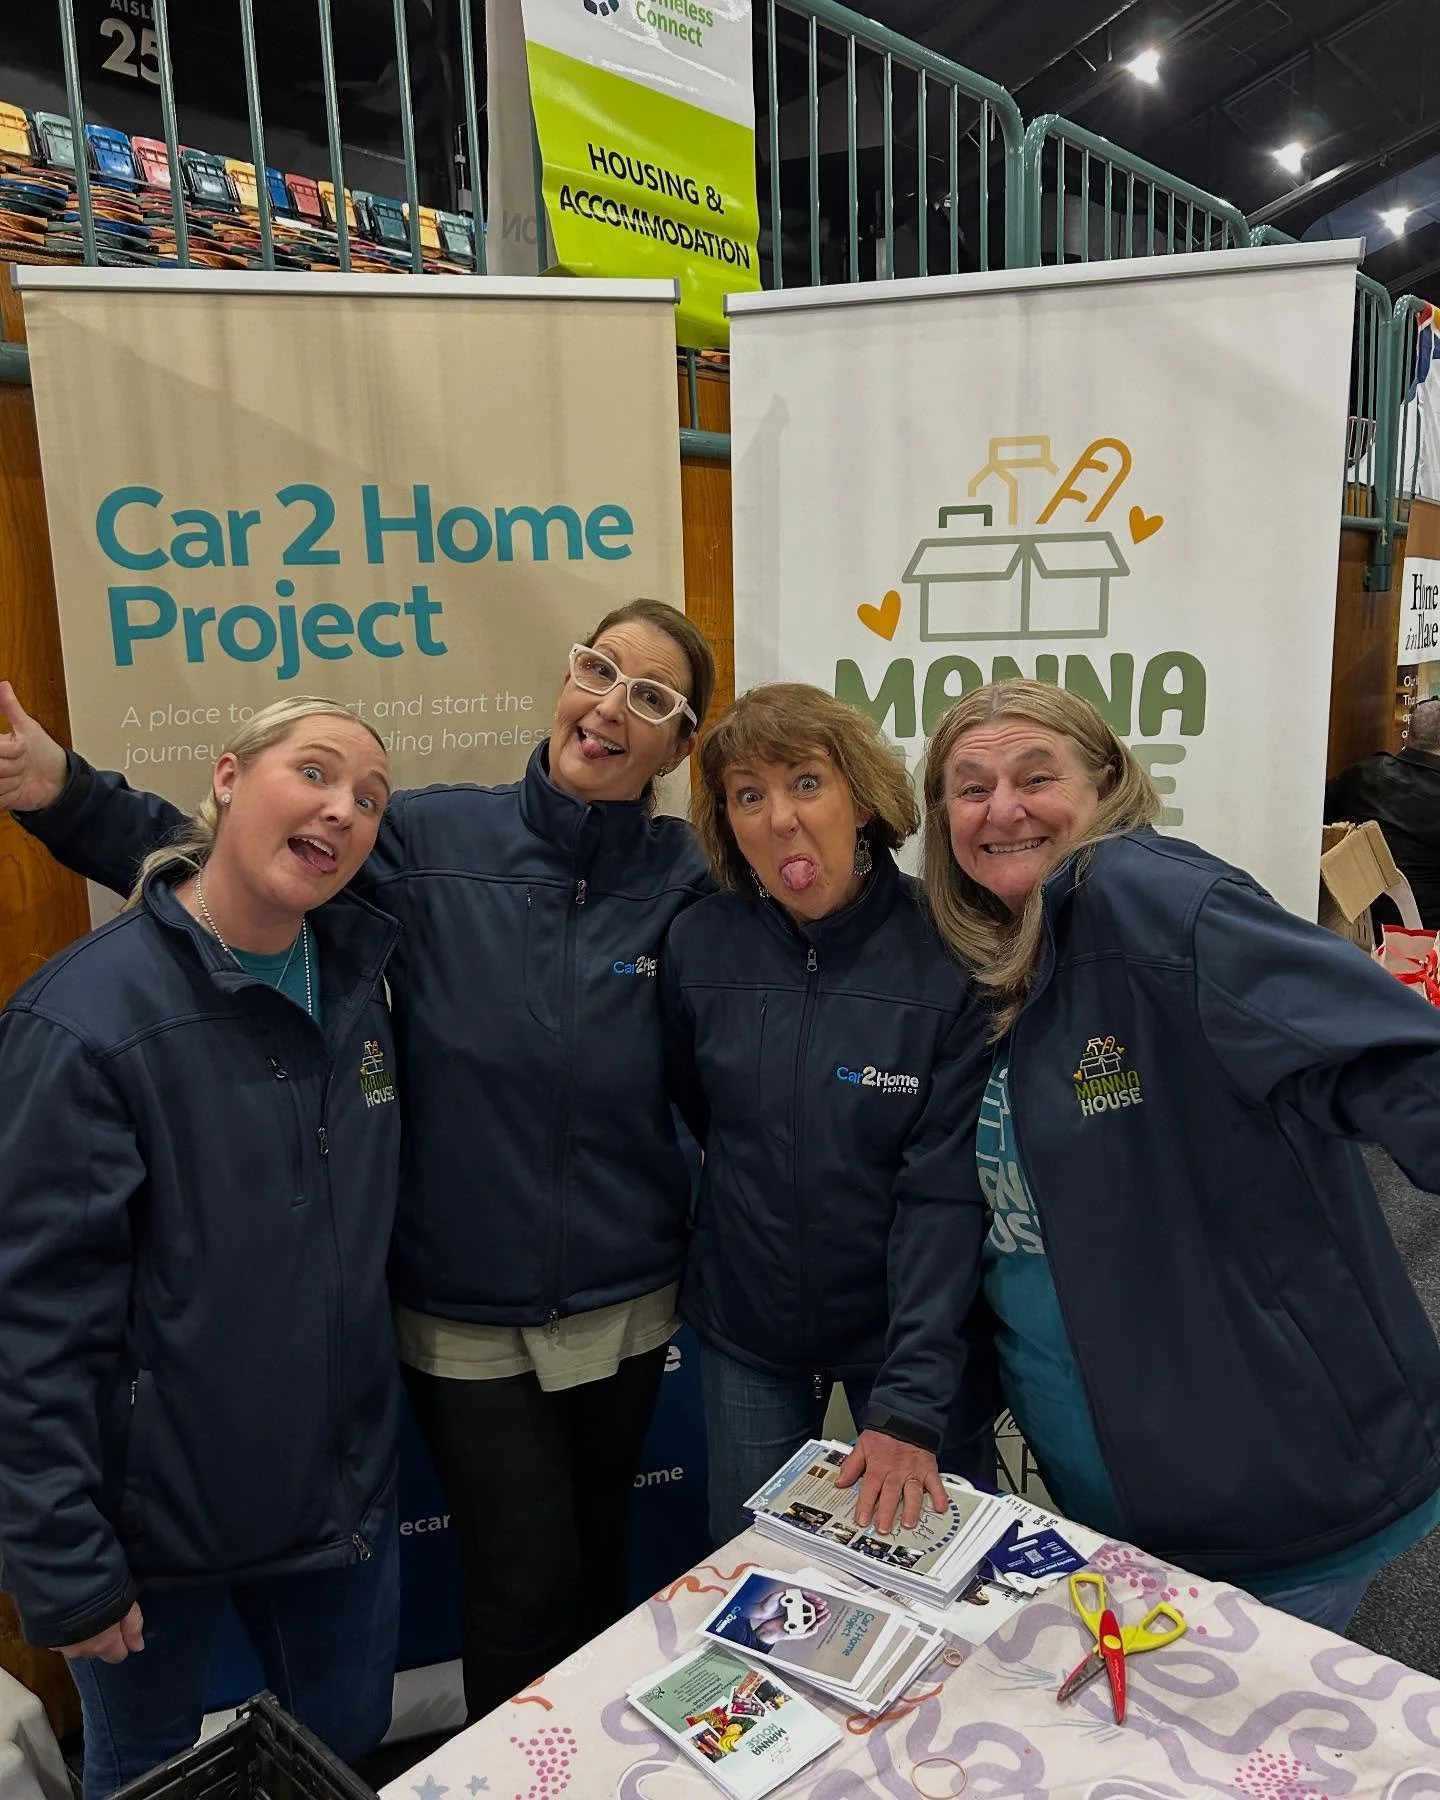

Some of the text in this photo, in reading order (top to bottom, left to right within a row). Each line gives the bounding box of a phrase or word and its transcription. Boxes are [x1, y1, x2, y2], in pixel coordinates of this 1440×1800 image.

[110, 0, 157, 21] AISL
[636, 1, 703, 48] Connect
[100, 17, 163, 85] 25
[588, 143, 725, 214] HOUSING &
[559, 184, 751, 269] ACCOMMODATION
[96, 484, 634, 571] Car 2 Home
[108, 579, 449, 680] Project
[121, 706, 142, 728] A
[149, 703, 221, 732] place
[228, 703, 255, 723] to
[374, 695, 423, 718] and
[431, 693, 488, 715] start
[495, 691, 534, 712] the
[124, 742, 225, 770] journey
[442, 724, 552, 750] homeles
[836, 1065, 919, 1088] Car2Home
[882, 1086, 918, 1095] PROJECT
[1073, 1070, 1140, 1102] MANNA
[1080, 1087, 1144, 1117] HOUSE
[841, 1609, 865, 1637] Project
[860, 1612, 875, 1627] Car
[842, 1631, 864, 1657] Home
[745, 1722, 778, 1750] HOUSE
[751, 1727, 787, 1756] MANNA
